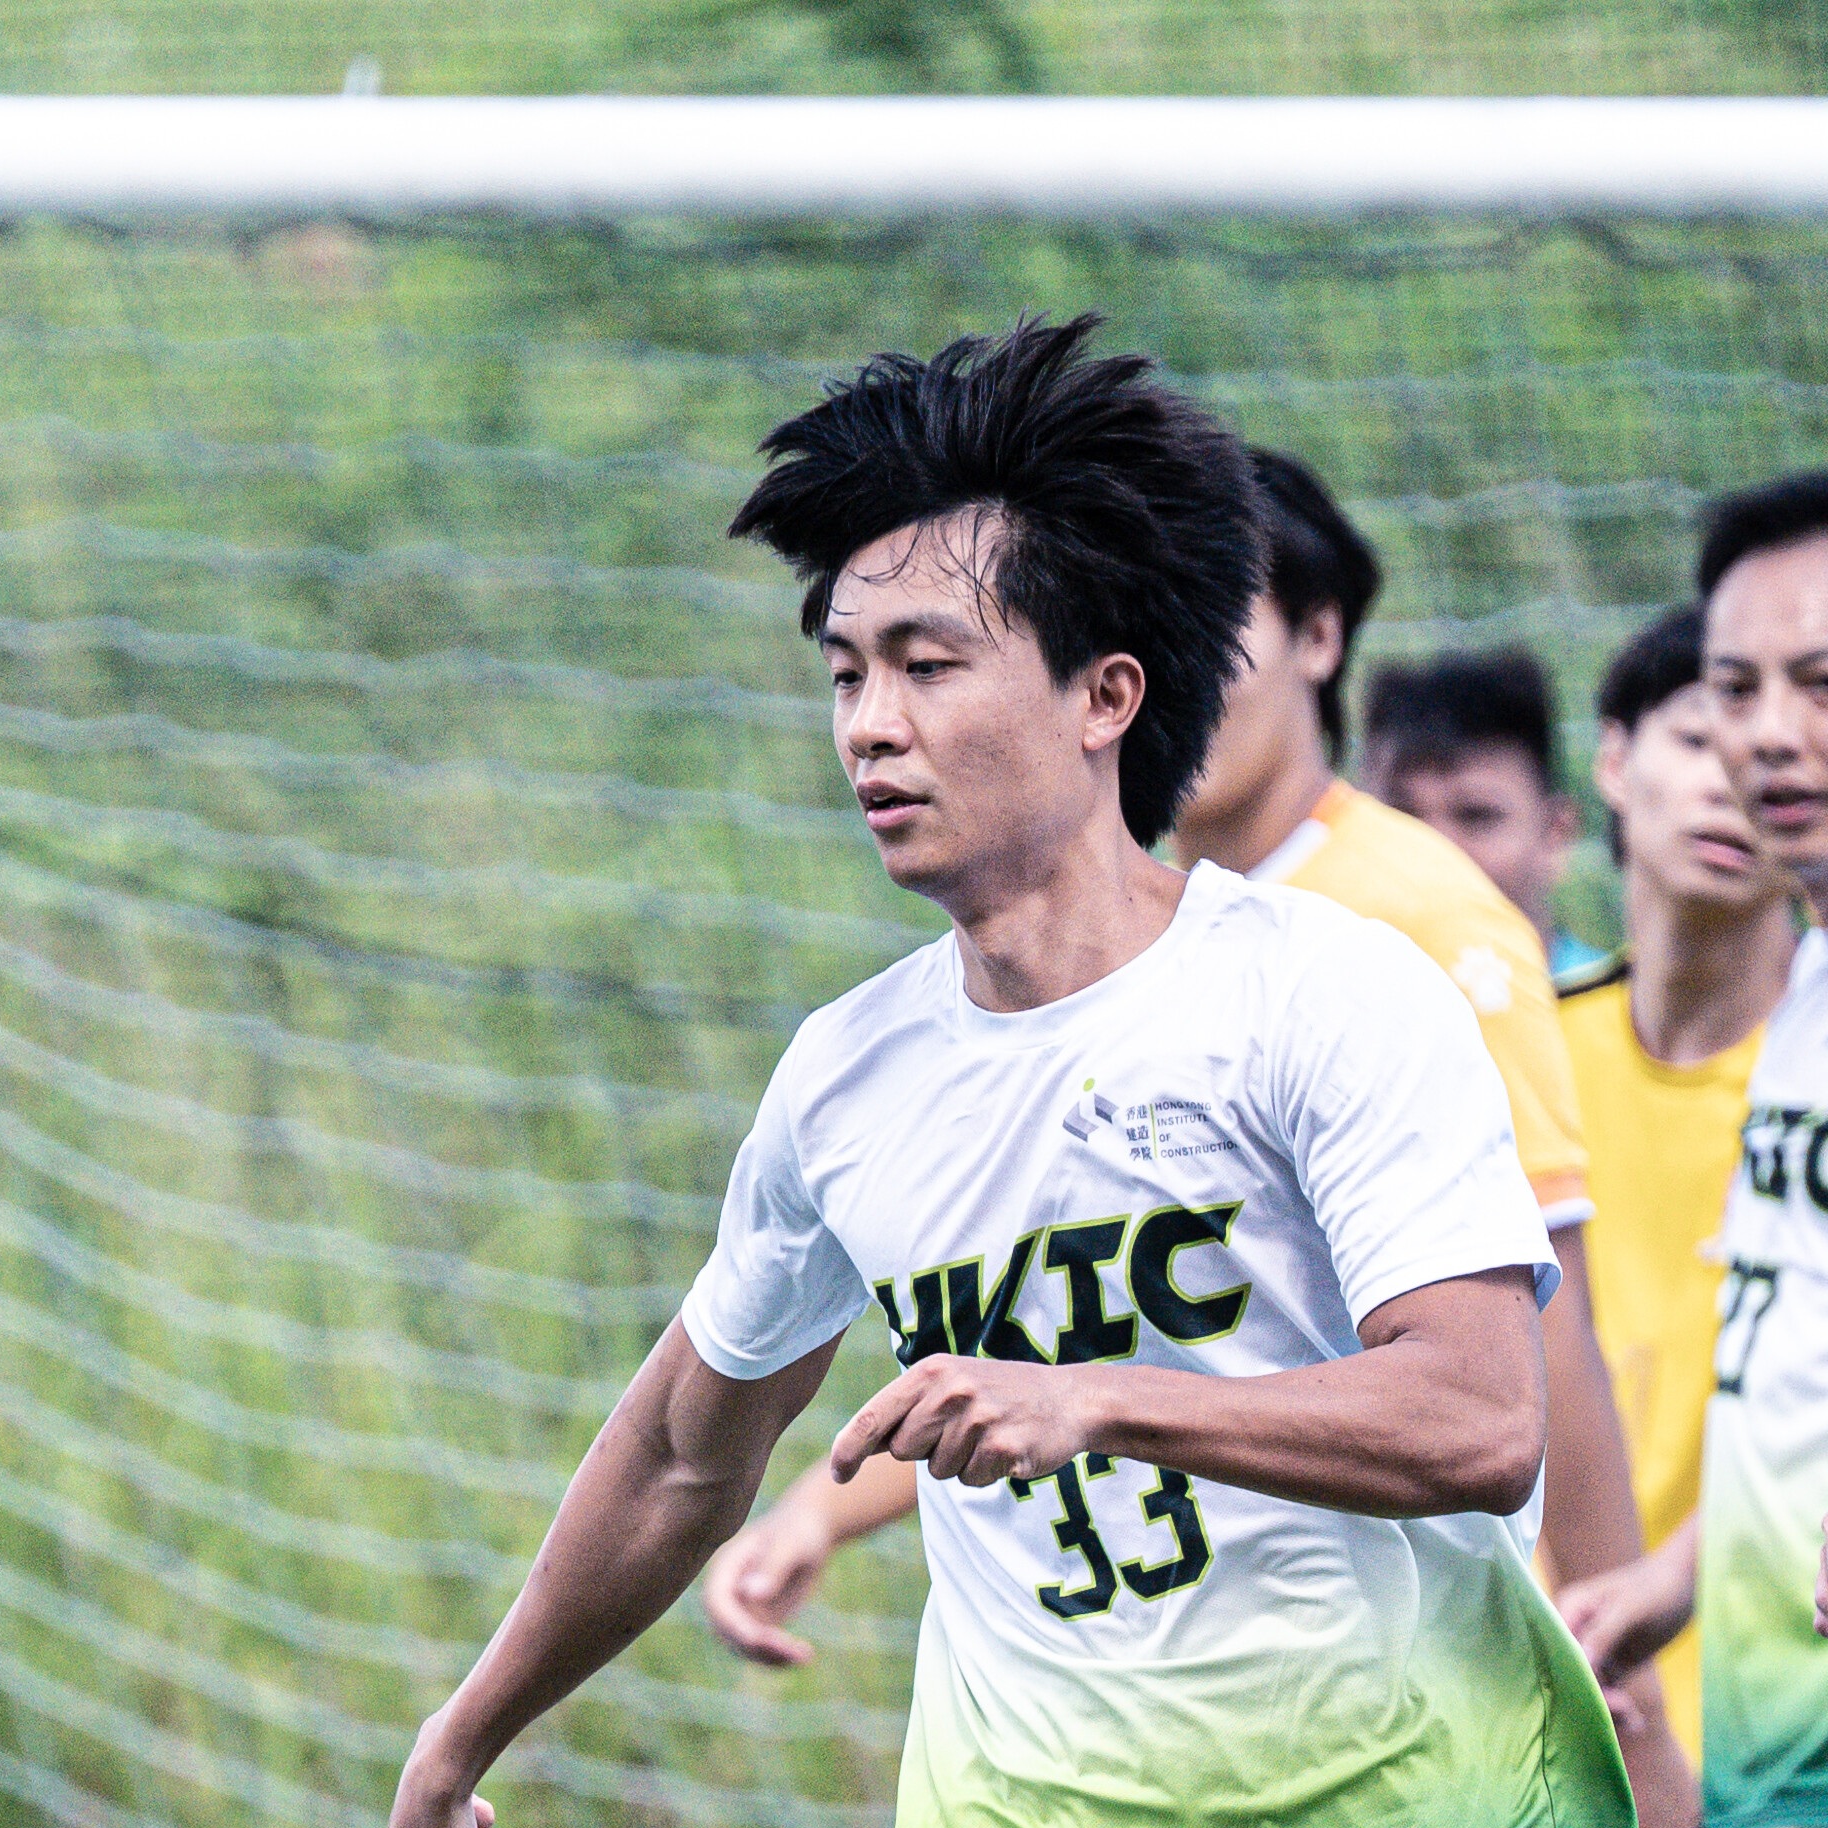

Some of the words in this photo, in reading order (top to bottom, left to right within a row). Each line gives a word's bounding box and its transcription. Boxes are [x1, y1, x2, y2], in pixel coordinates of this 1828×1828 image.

[1155, 1101, 1183, 1112] HONG
[1158, 1133, 1171, 1143] OF
[873, 1200, 1253, 1368] HKIC
[1006, 1450, 1215, 1623] 33
